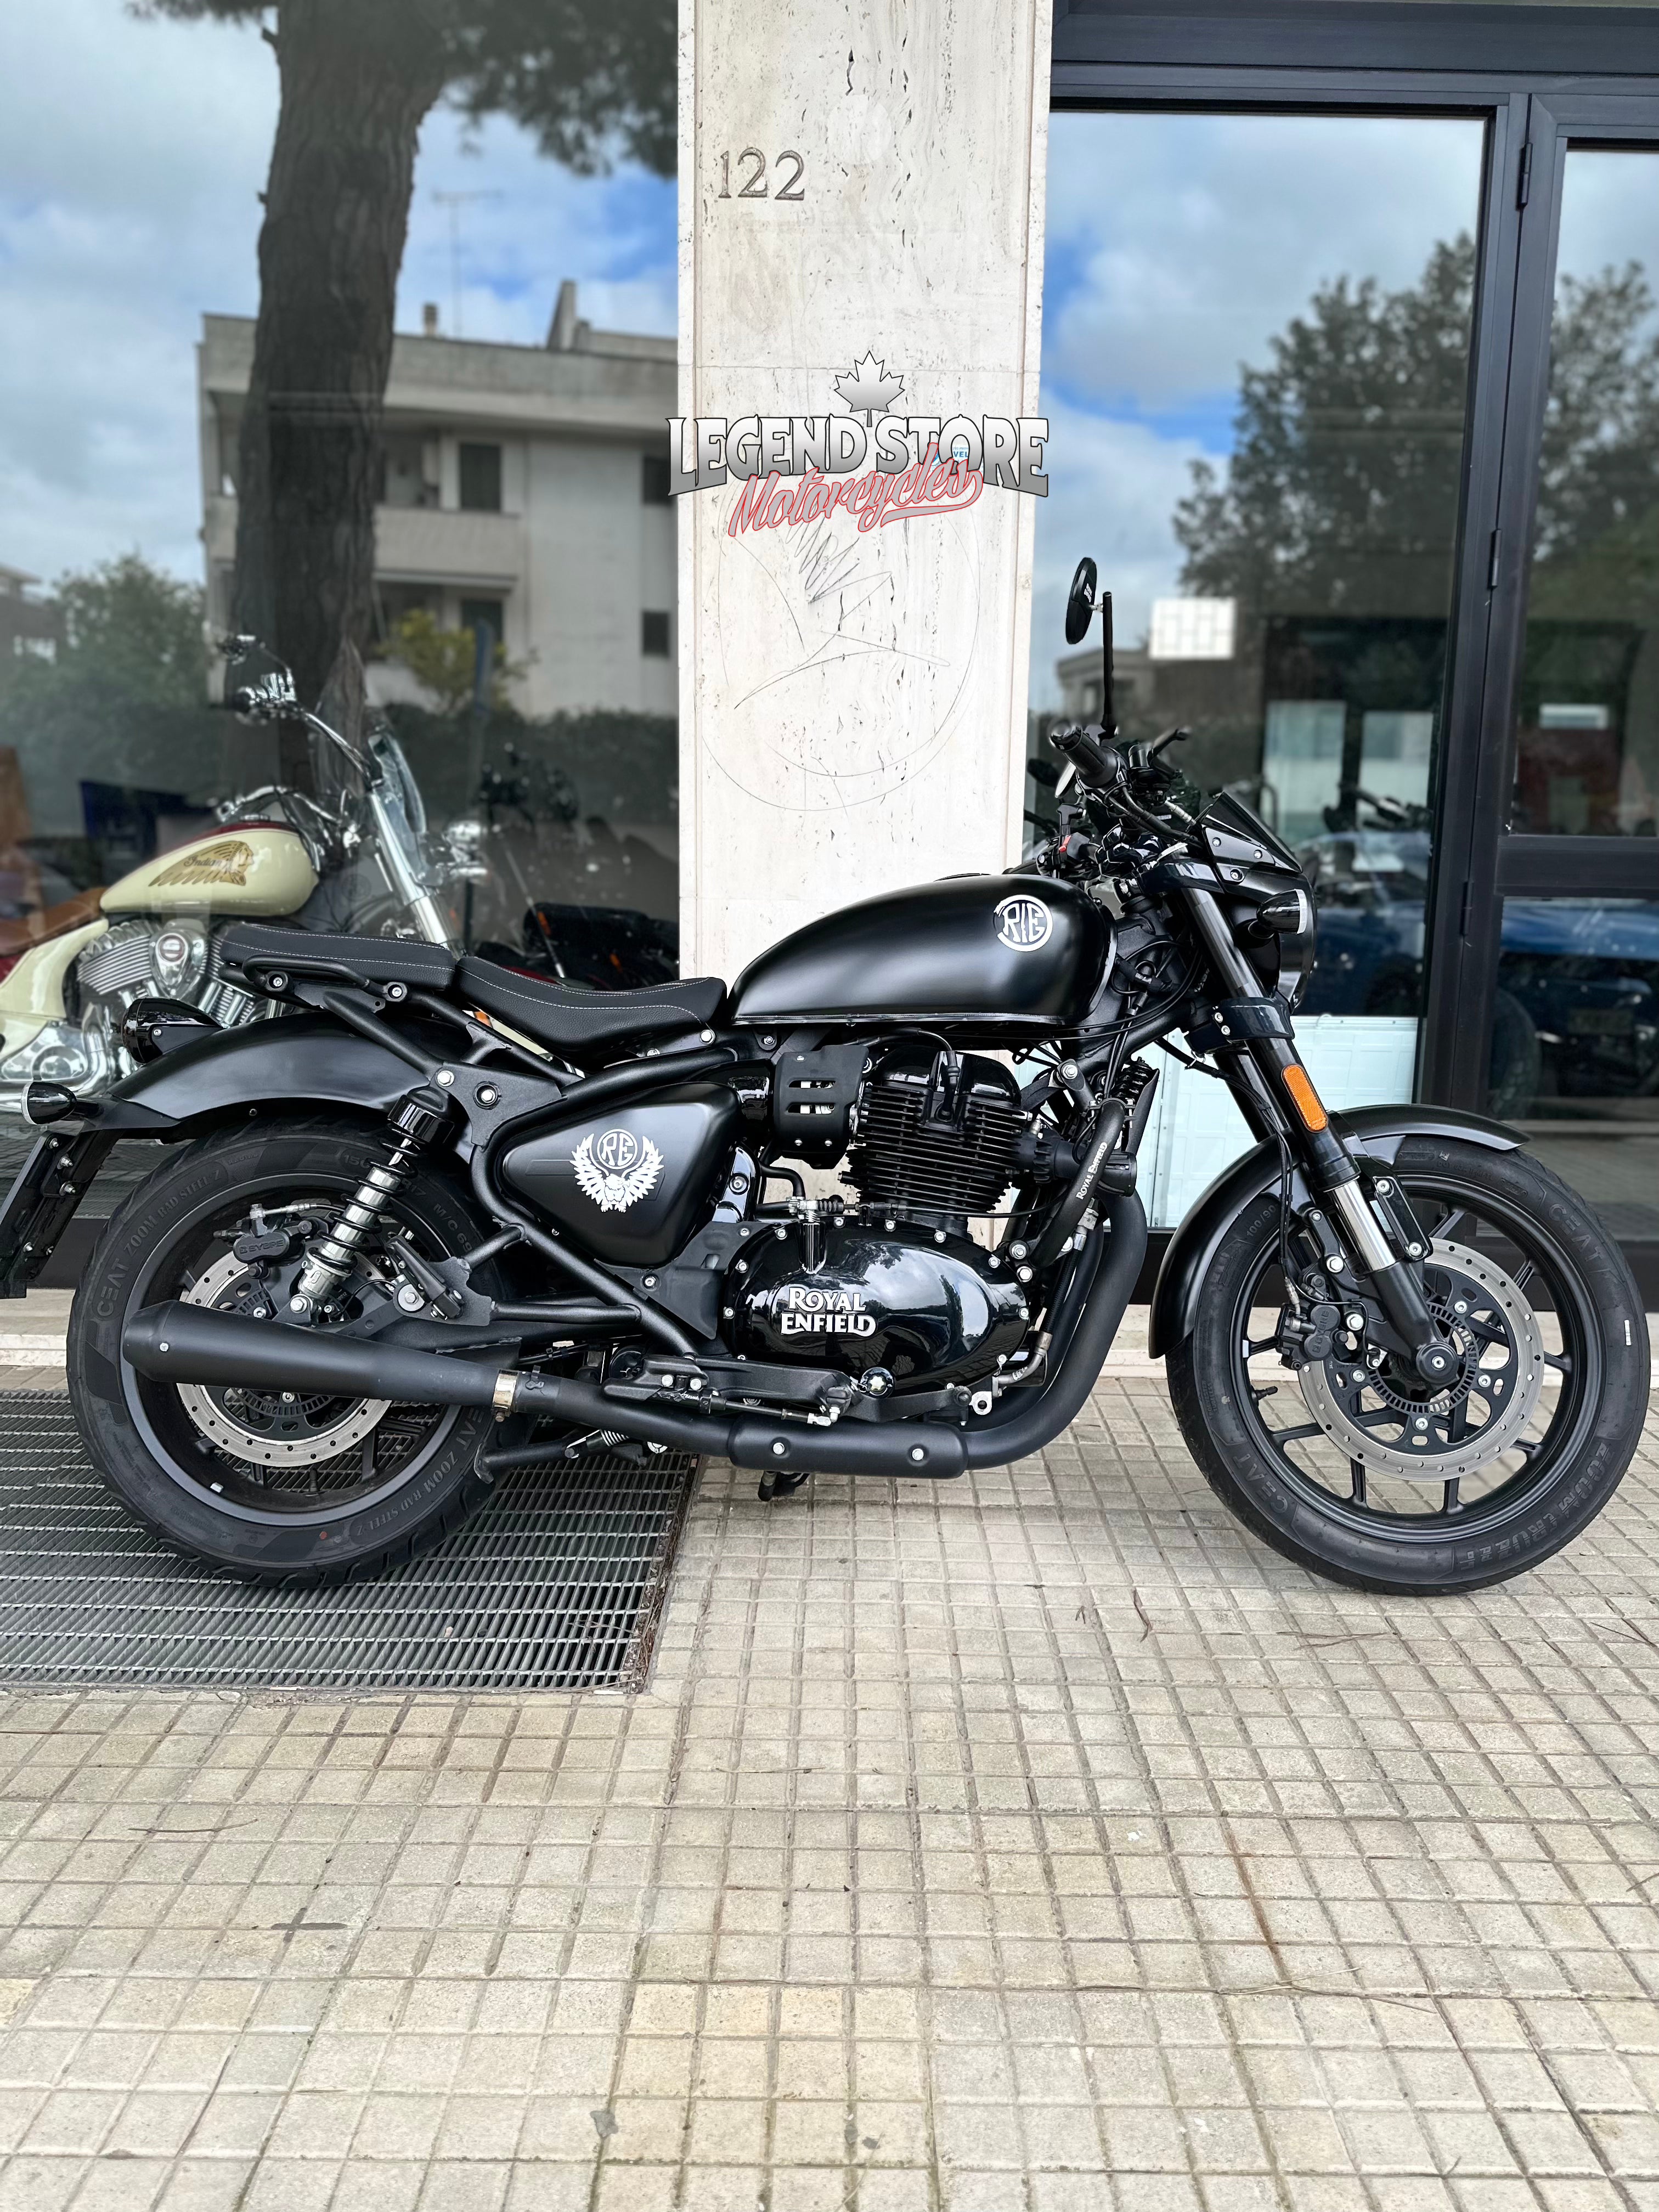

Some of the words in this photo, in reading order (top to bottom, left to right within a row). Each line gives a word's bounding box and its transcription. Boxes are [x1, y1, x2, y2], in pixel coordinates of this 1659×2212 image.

[717, 146, 805, 201] 122
[184, 855, 222, 867] Indian
[601, 1133, 634, 1166] RE
[1075, 1172, 1094, 1200] ROYAL
[1088, 1142, 1108, 1175] ENFIELD
[433, 1203, 458, 1232] M/C
[1246, 1204, 1277, 1237] 100/90
[1549, 1203, 1605, 1262] CEAT
[97, 1258, 130, 1317] CEAT
[123, 1215, 159, 1257] ZOOM
[157, 1197, 179, 1218] RAD
[788, 1286, 867, 1312] ROYAL
[781, 1312, 877, 1338] ENFIELD
[456, 1407, 486, 1451] EAT
[422, 1451, 459, 1493] ZOOM
[1233, 1453, 1289, 1514] CEAT
[1558, 1442, 1615, 1519] ZOOM
[400, 1489, 422, 1511] RAD
